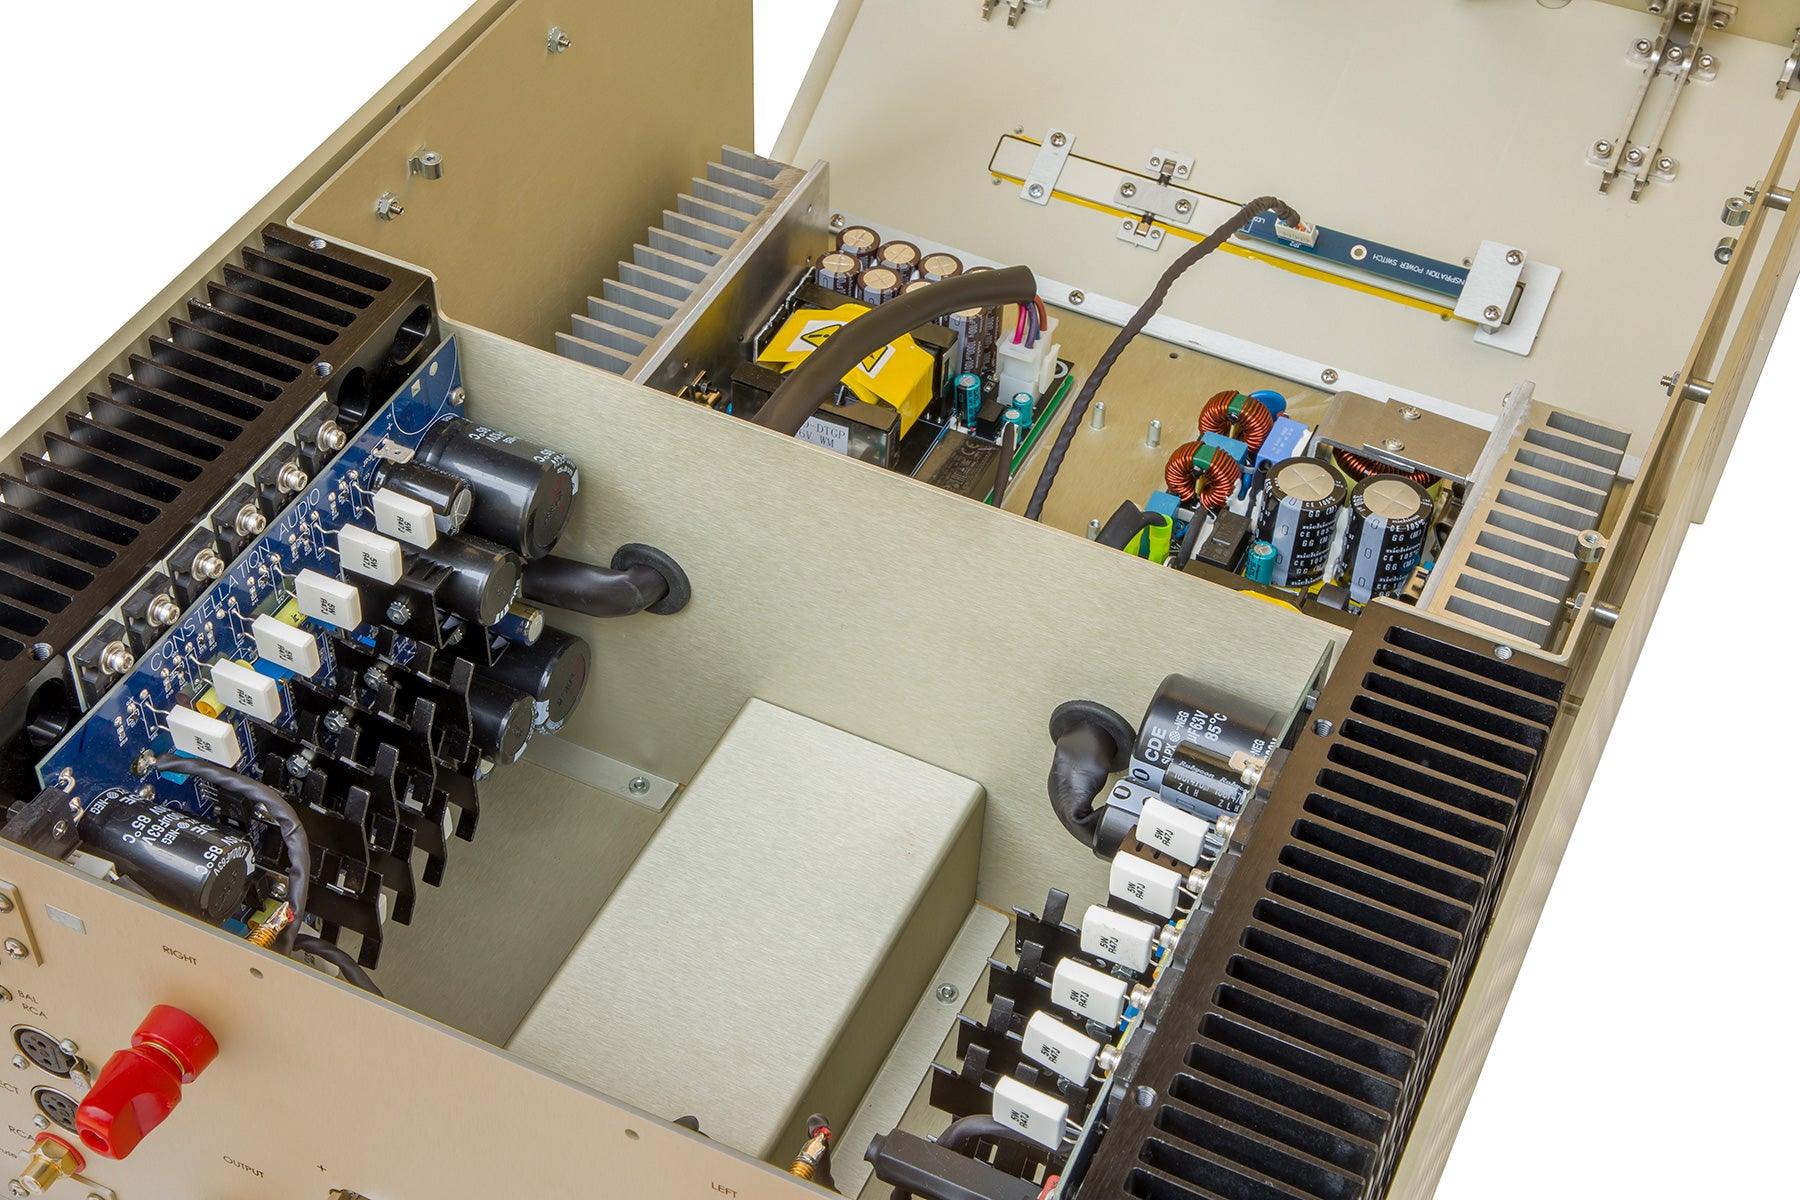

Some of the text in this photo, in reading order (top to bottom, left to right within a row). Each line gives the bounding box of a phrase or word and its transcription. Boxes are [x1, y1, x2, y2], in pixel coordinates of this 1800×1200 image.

[1372, 253, 1465, 285] NSPIRATION POWER SWITCH
[280, 487, 320, 541] AUDIO
[1204, 712, 1228, 742] 85°C
[1144, 726, 1167, 762] CDE
[122, 814, 152, 844] 85°C
[1154, 827, 1164, 841] 5W
[1162, 829, 1174, 847] R47J
[194, 845, 224, 875] 85°C
[1127, 881, 1137, 894] 5W
[1135, 882, 1146, 900] R47J
[1099, 936, 1109, 948] 5W
[1108, 936, 1119, 955] R47J
[162, 945, 198, 967] RIGHT
[17, 989, 40, 1005] BAL
[1069, 989, 1080, 1003] 5W
[1078, 991, 1090, 1009] R47J
[22, 1003, 48, 1020] RCA
[1040, 1043, 1051, 1057] 5W
[1048, 1046, 1061, 1064] R47J
[1010, 1109, 1020, 1122] 5W
[1019, 1111, 1030, 1129] R47J
[8, 1124, 36, 1141] RCA
[223, 1155, 265, 1178] OUTPUT
[711, 1181, 738, 1199] LEFT
